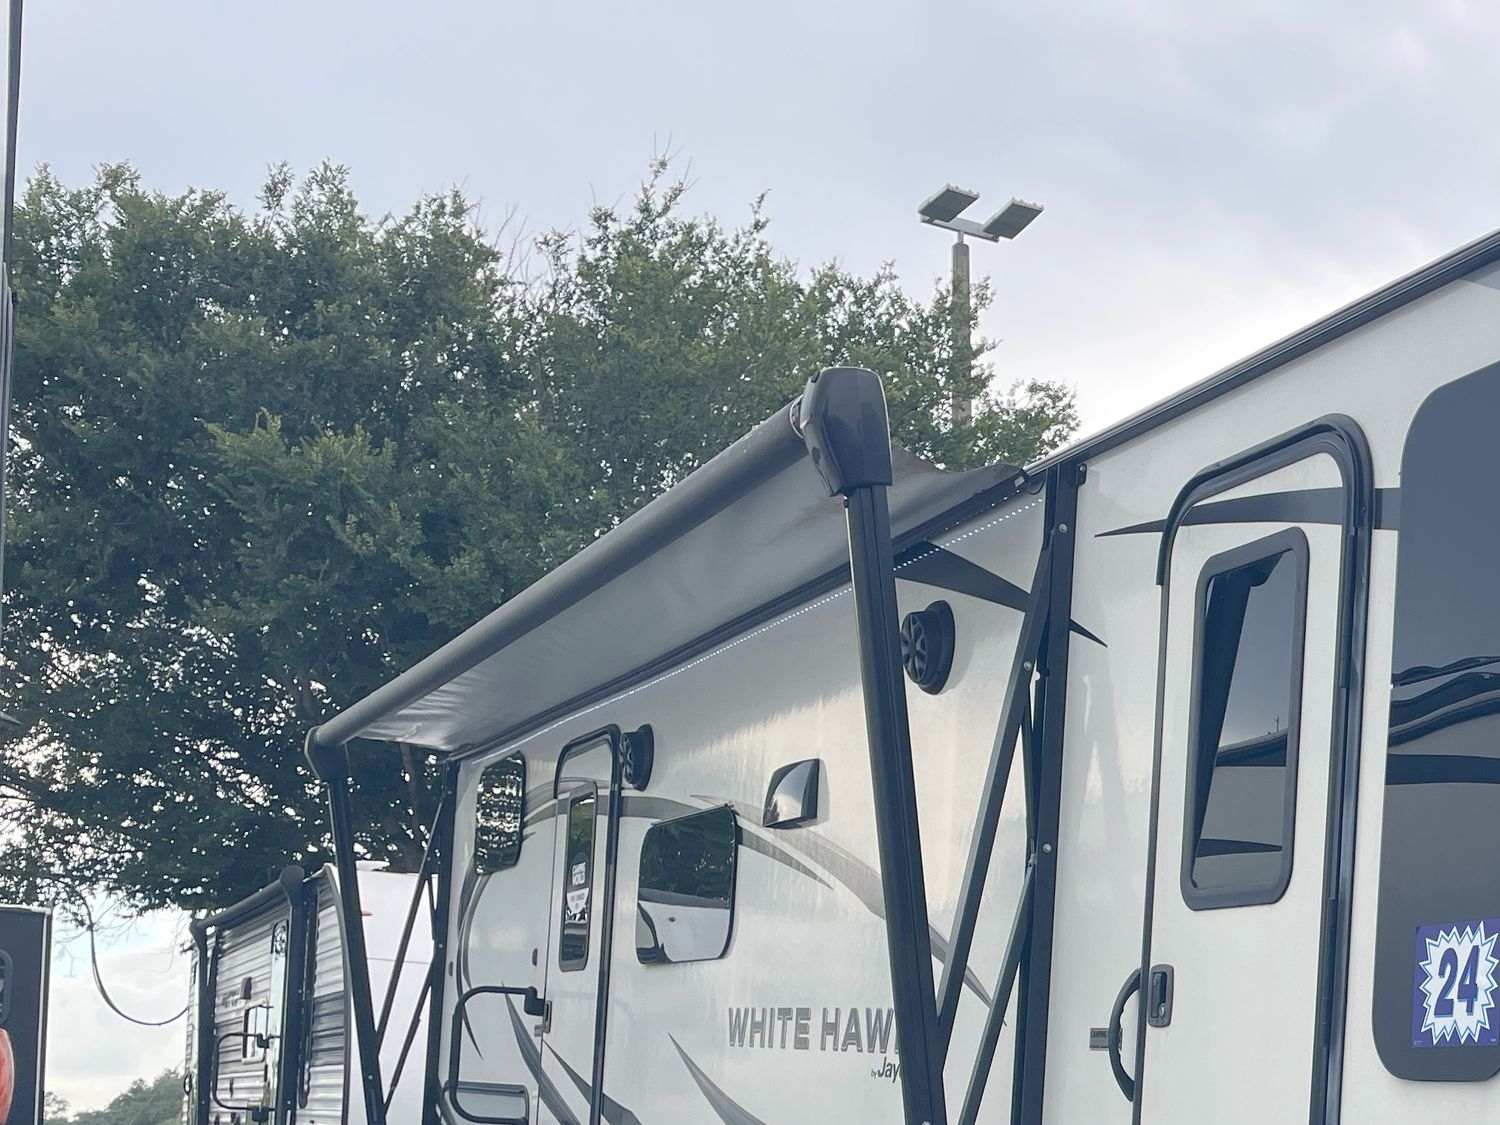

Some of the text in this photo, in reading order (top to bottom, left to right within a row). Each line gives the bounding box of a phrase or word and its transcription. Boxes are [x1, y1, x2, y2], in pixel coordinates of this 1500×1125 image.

[1433, 945, 1480, 1018] 24
[728, 1007, 900, 1054] WHITE HAW
[877, 1056, 900, 1083] Jay
